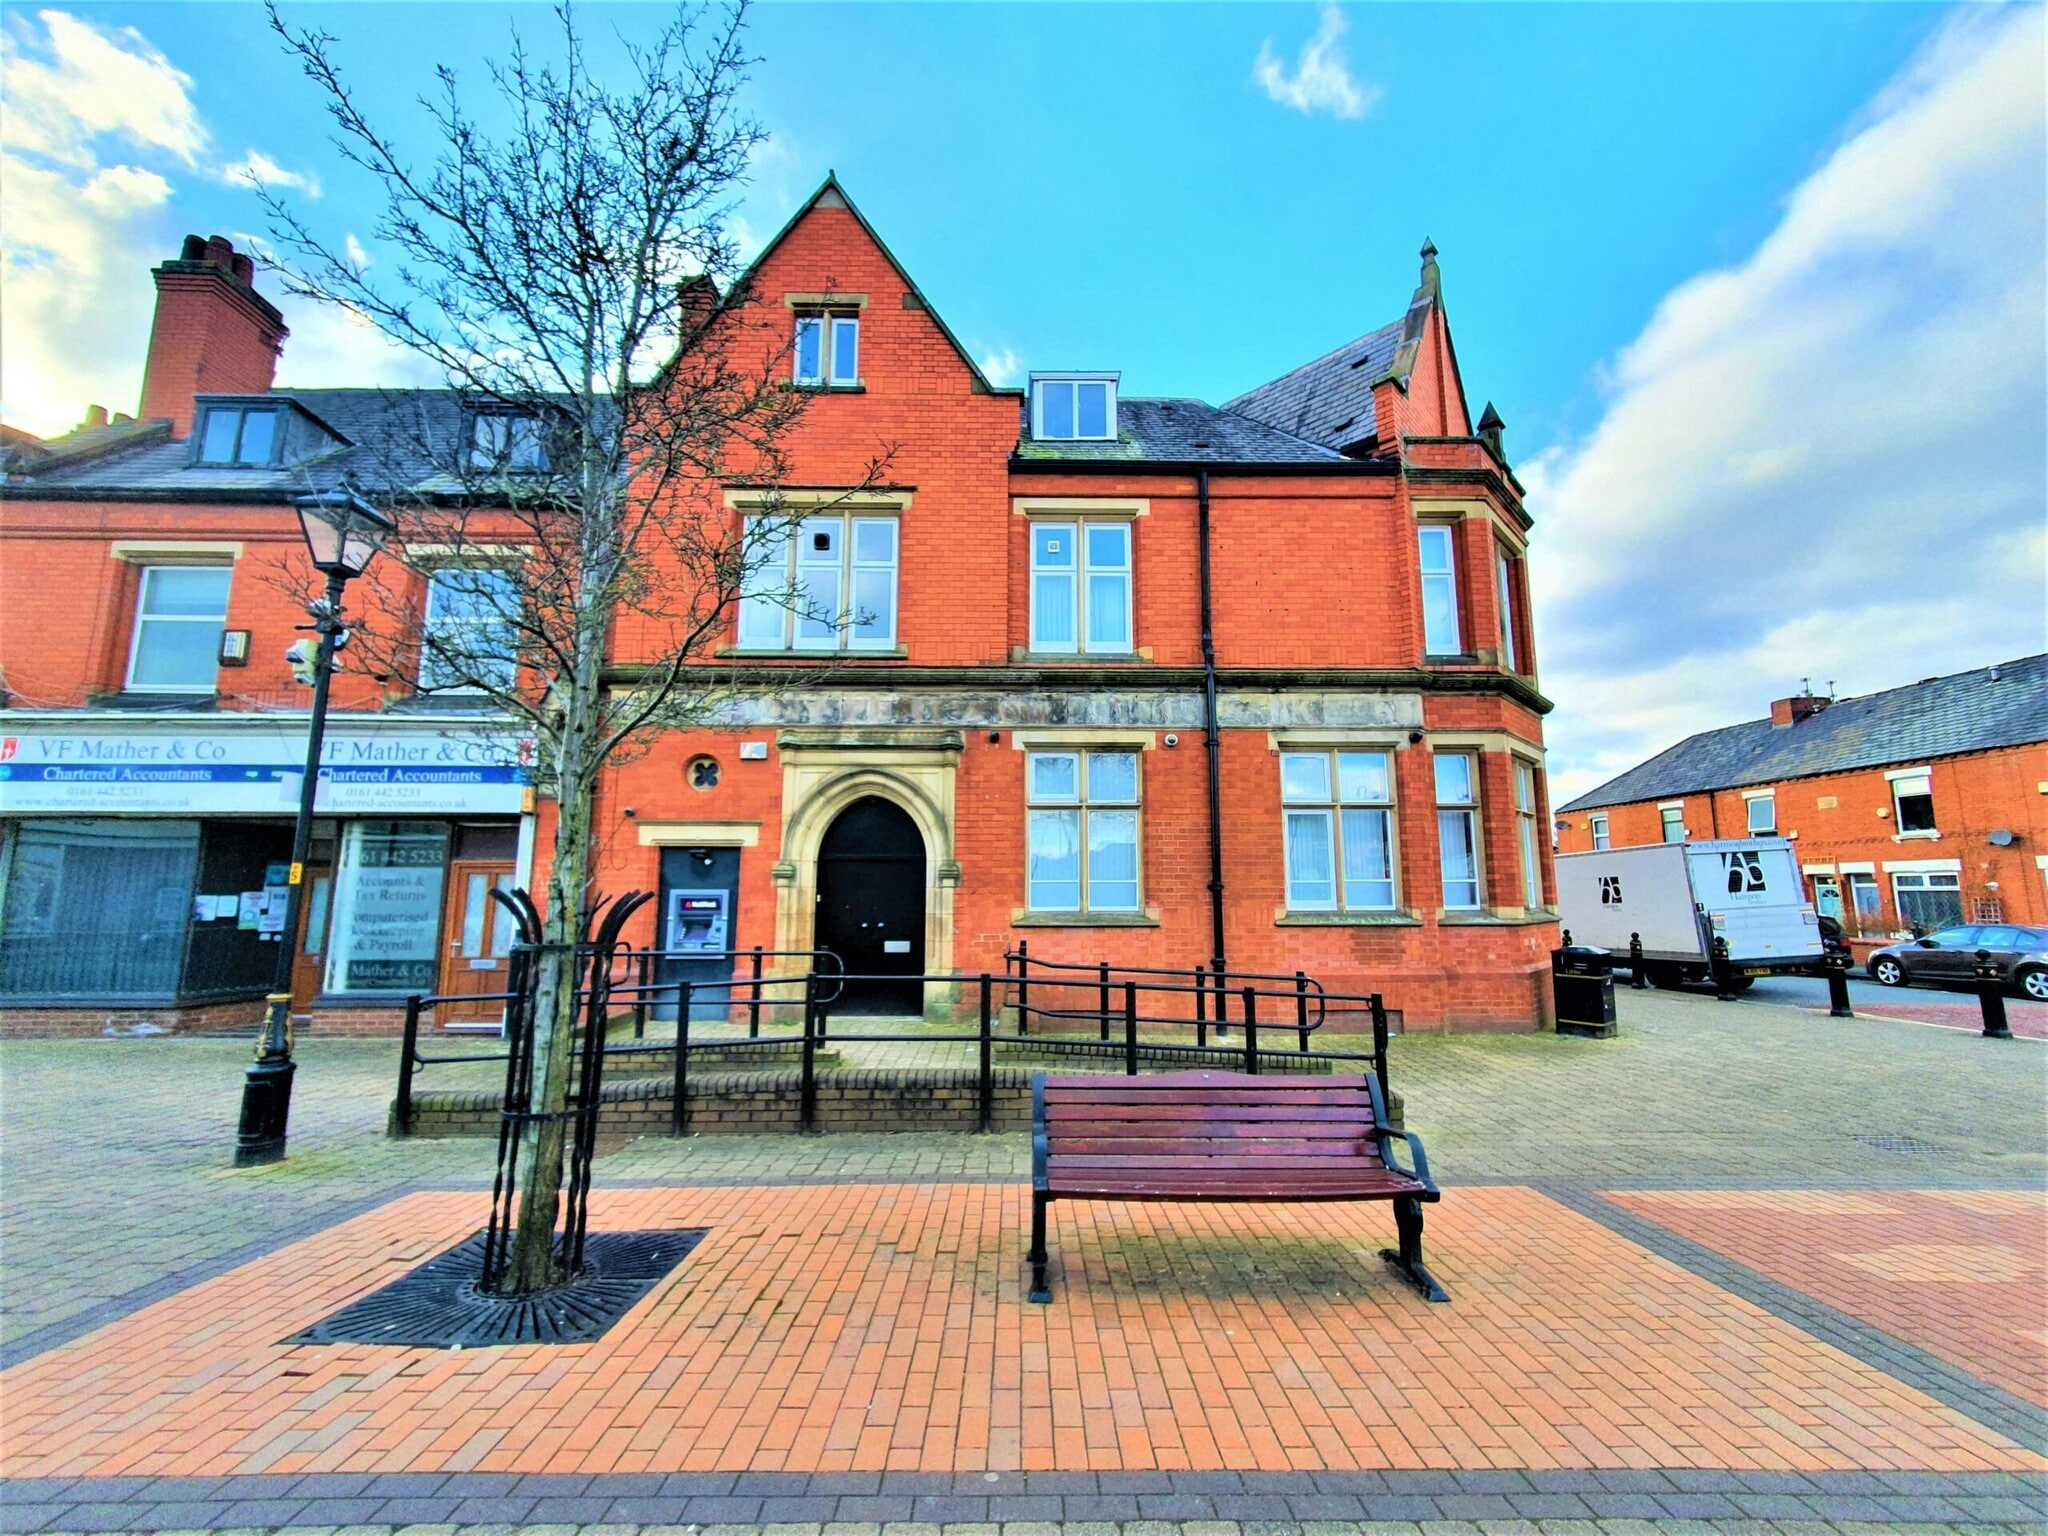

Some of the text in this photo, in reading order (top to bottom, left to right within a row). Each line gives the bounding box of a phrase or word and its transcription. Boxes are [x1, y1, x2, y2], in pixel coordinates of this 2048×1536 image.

[40, 740, 225, 760] VF Mather & Co
[351, 742, 429, 761] Mather
[436, 742, 455, 761] &
[464, 743, 494, 762] Co
[43, 766, 212, 781] Chartered Accountants
[392, 769, 482, 782] Accountants
[346, 787, 421, 799] 0161 442 5233
[410, 851, 443, 864] 5233
[354, 911, 429, 924] omputerised
[352, 963, 396, 977] Mather
